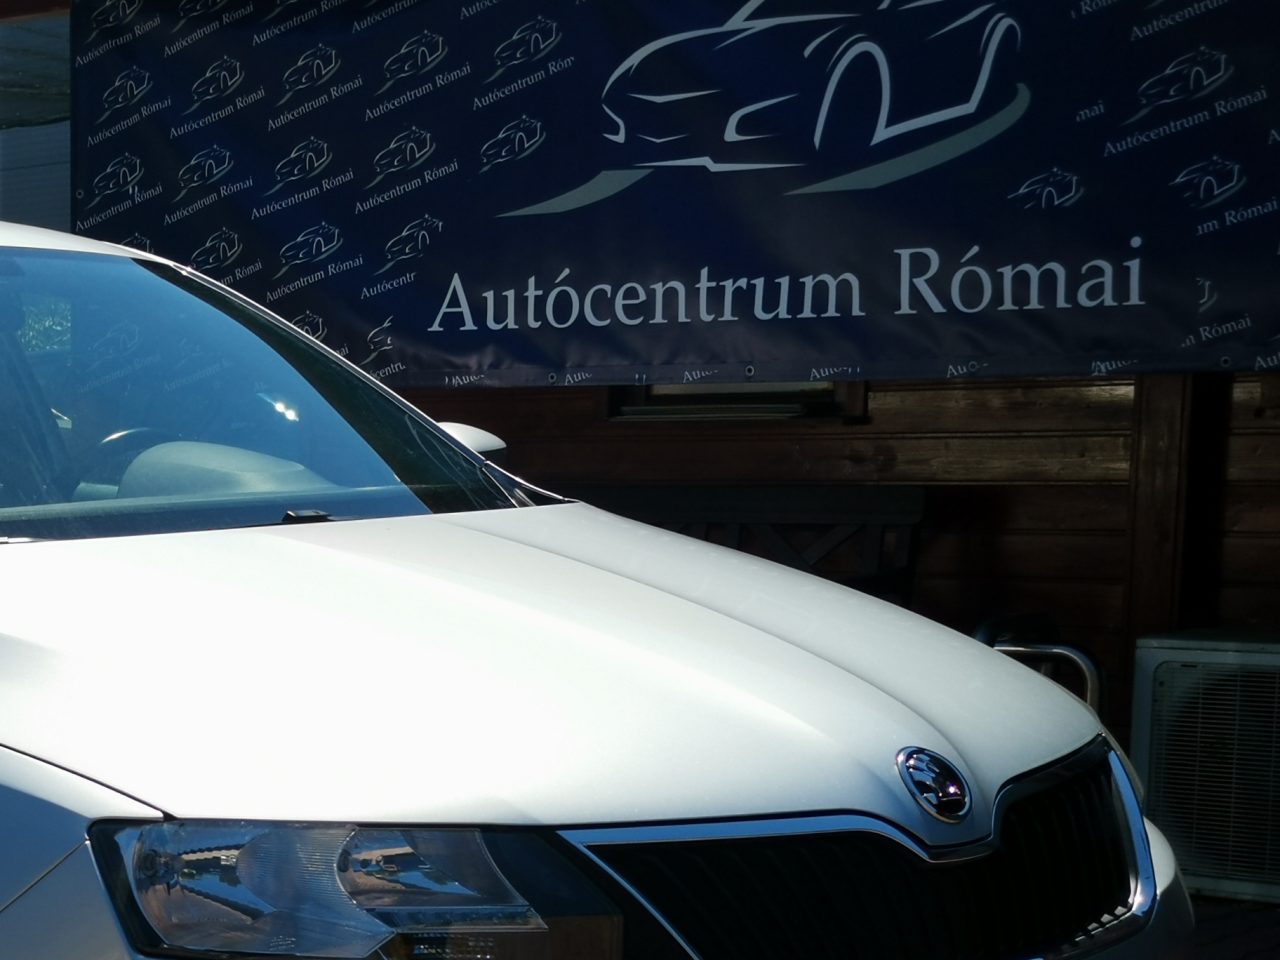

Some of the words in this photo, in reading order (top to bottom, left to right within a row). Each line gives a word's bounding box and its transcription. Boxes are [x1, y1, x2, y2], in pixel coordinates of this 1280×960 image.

[75, 32, 133, 67] Autócentrum
[134, 12, 161, 36] Római
[164, 18, 220, 58] Autócentrum
[222, 1, 254, 25] Római
[252, 8, 319, 46] Autócentrum
[170, 105, 234, 139] Autócentrum
[235, 85, 266, 110] Római
[267, 94, 329, 132] Autócentrum
[330, 74, 363, 99] Római
[364, 83, 433, 122] Autócentrum
[435, 61, 472, 88] Római
[472, 69, 546, 111] Autócentrum
[87, 111, 140, 148] Autócentrum
[140, 96, 172, 118] Római
[1103, 110, 1211, 157] Autócentrum
[1214, 84, 1268, 117] Római
[163, 191, 218, 226] Autócentrum
[220, 176, 254, 198] Római
[250, 186, 320, 220] Autócentrum
[322, 168, 355, 192] Római
[354, 176, 422, 215] Autócentrum
[424, 158, 460, 183] Római
[1224, 195, 1279, 226] Római
[75, 199, 132, 232] Autócentrum
[235, 257, 263, 280] Római
[266, 270, 325, 303] Autócentrum
[328, 254, 363, 277] Római
[427, 265, 866, 333] Autócentrum
[893, 236, 1146, 316] Római
[1199, 313, 1252, 342] Római
